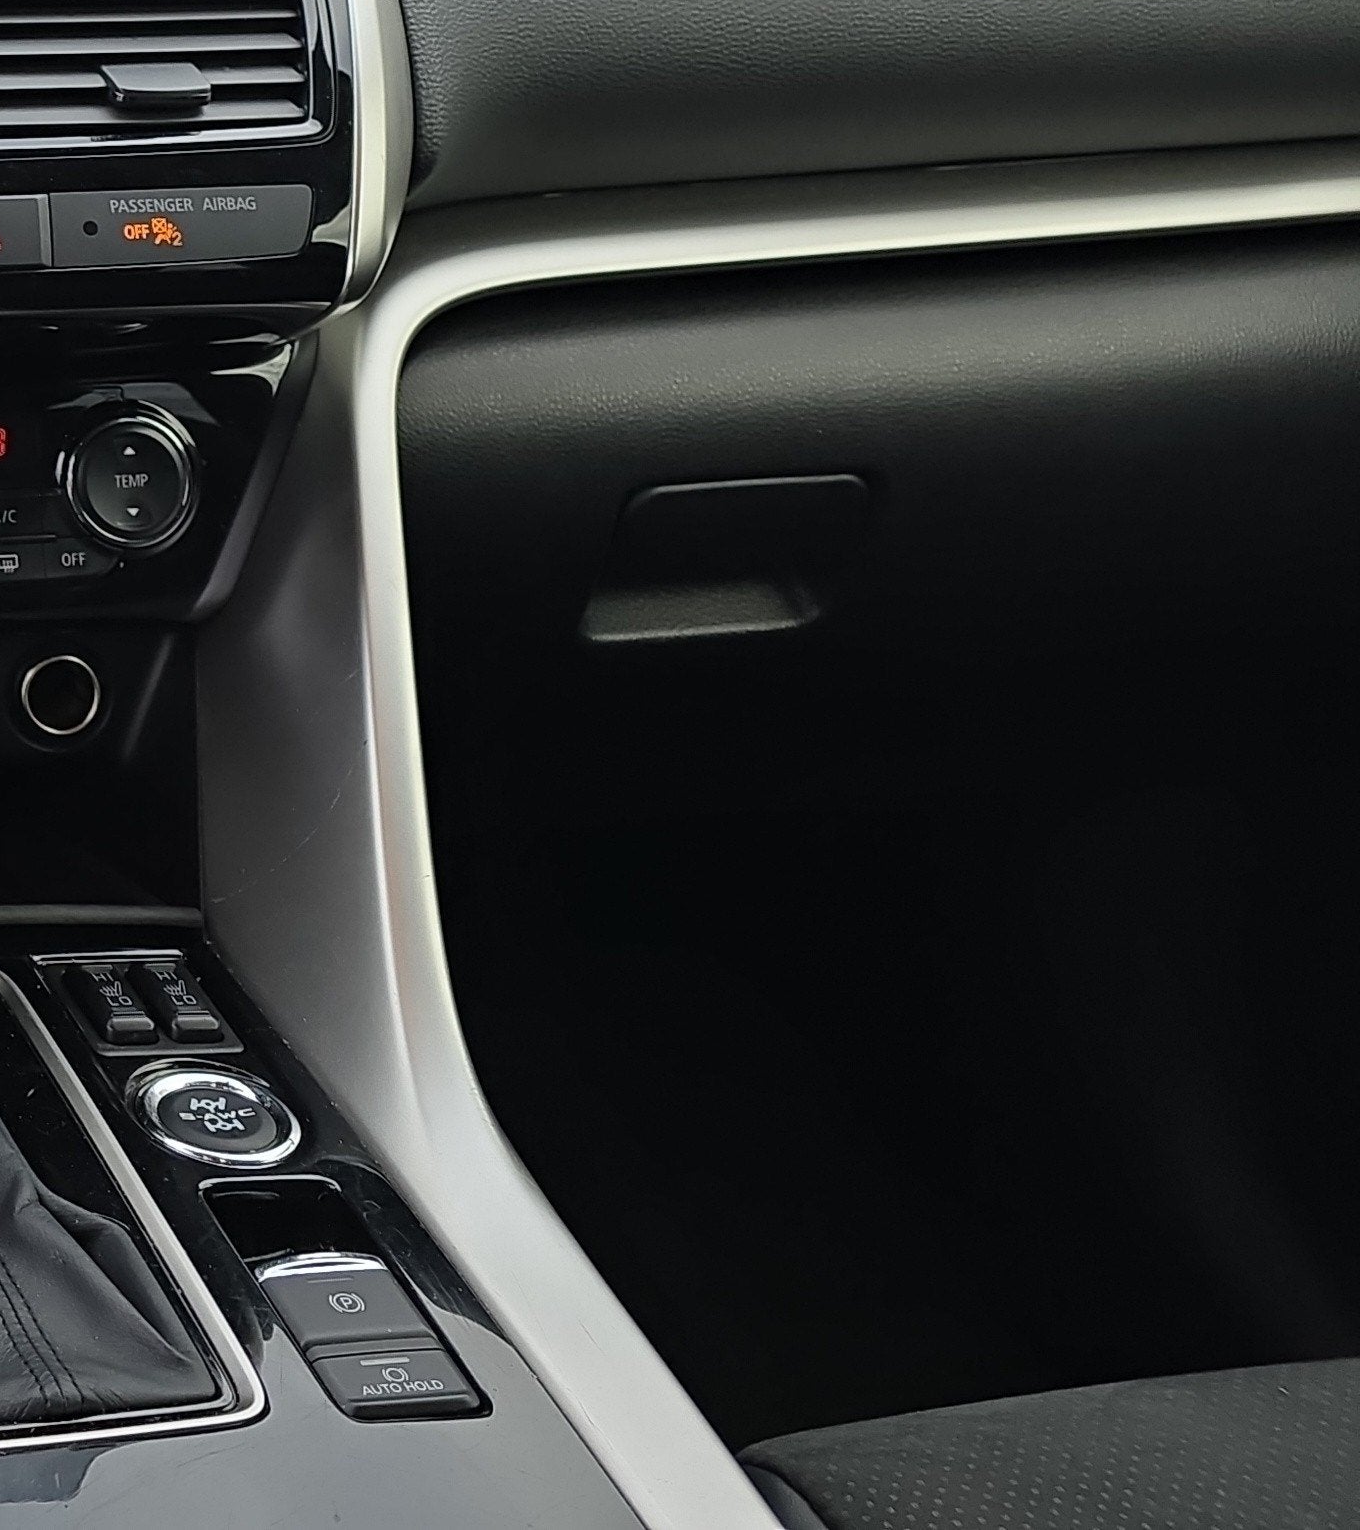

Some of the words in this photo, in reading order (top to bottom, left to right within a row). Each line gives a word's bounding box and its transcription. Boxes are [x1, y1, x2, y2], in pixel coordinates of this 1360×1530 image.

[109, 197, 194, 214] PASSENGER
[202, 195, 257, 212] AIRBAG
[123, 224, 150, 241] OFF
[114, 473, 149, 489] TEMP
[61, 552, 86, 567] OFF
[106, 996, 133, 1006] LO
[171, 995, 197, 1006] LO
[362, 1383, 402, 1396] AUTO
[403, 1380, 444, 1391] HOLD
